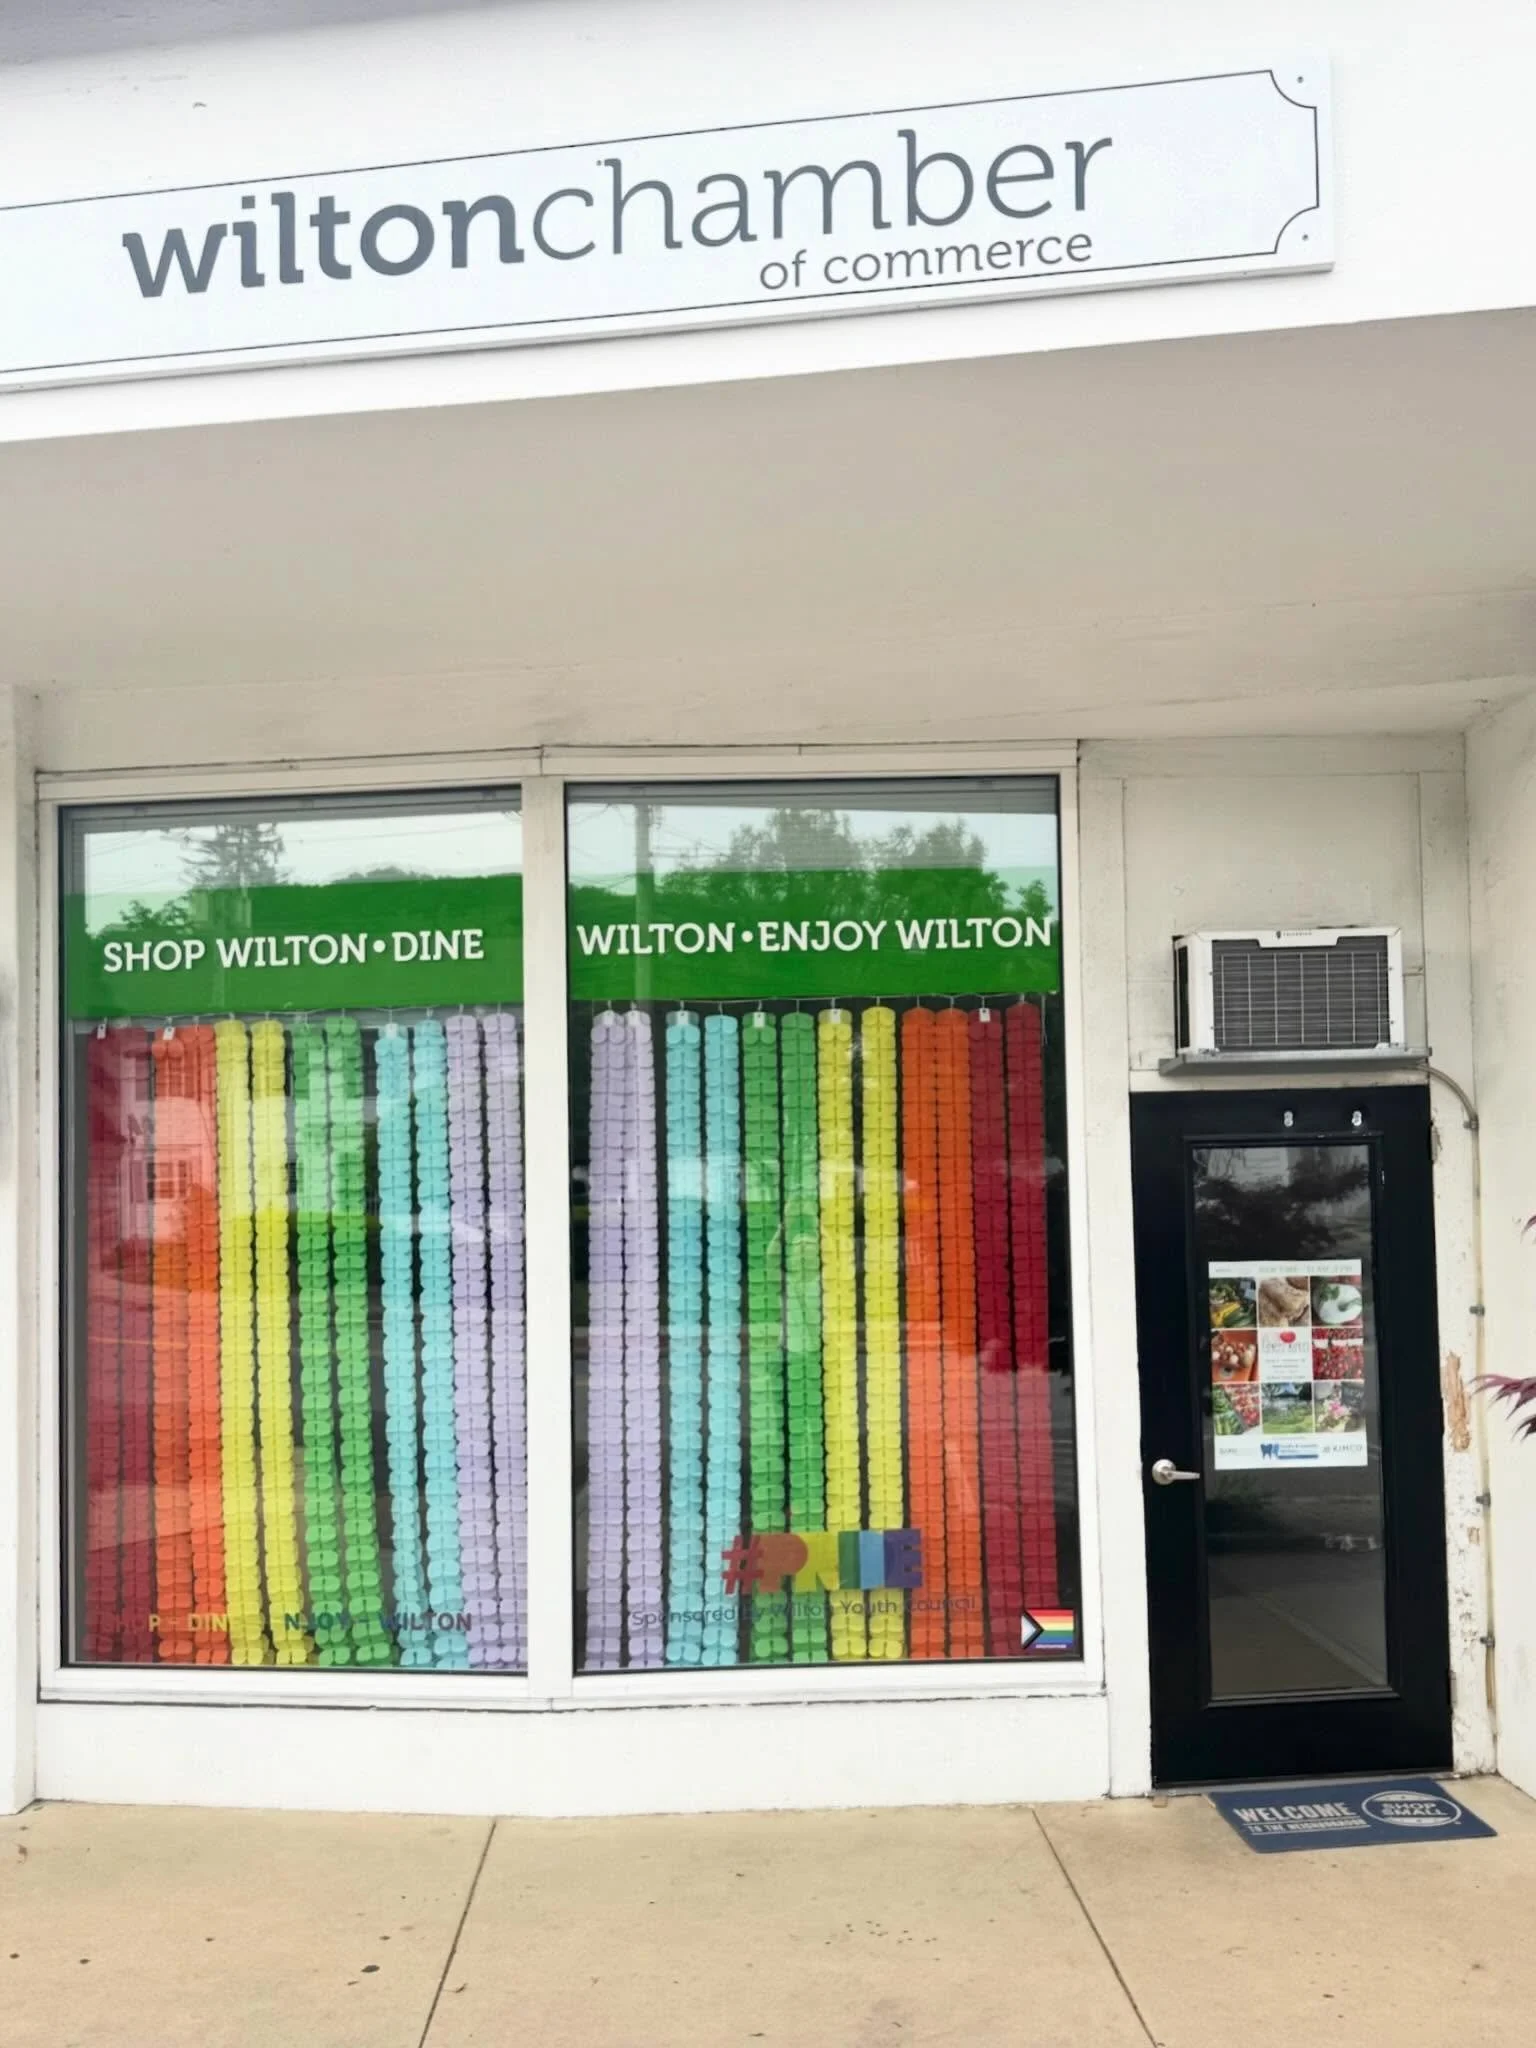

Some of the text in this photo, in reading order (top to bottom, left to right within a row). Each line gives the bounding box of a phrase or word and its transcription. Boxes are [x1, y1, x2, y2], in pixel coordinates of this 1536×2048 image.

[759, 229, 1093, 290] of commerce
[103, 916, 1053, 973] SHOP WILTON DINE WILTON ENJOY WILTON
[631, 1606, 736, 1630] Sponsored
[840, 1598, 897, 1616] Youth
[1232, 1802, 1357, 1822] WELCOME
